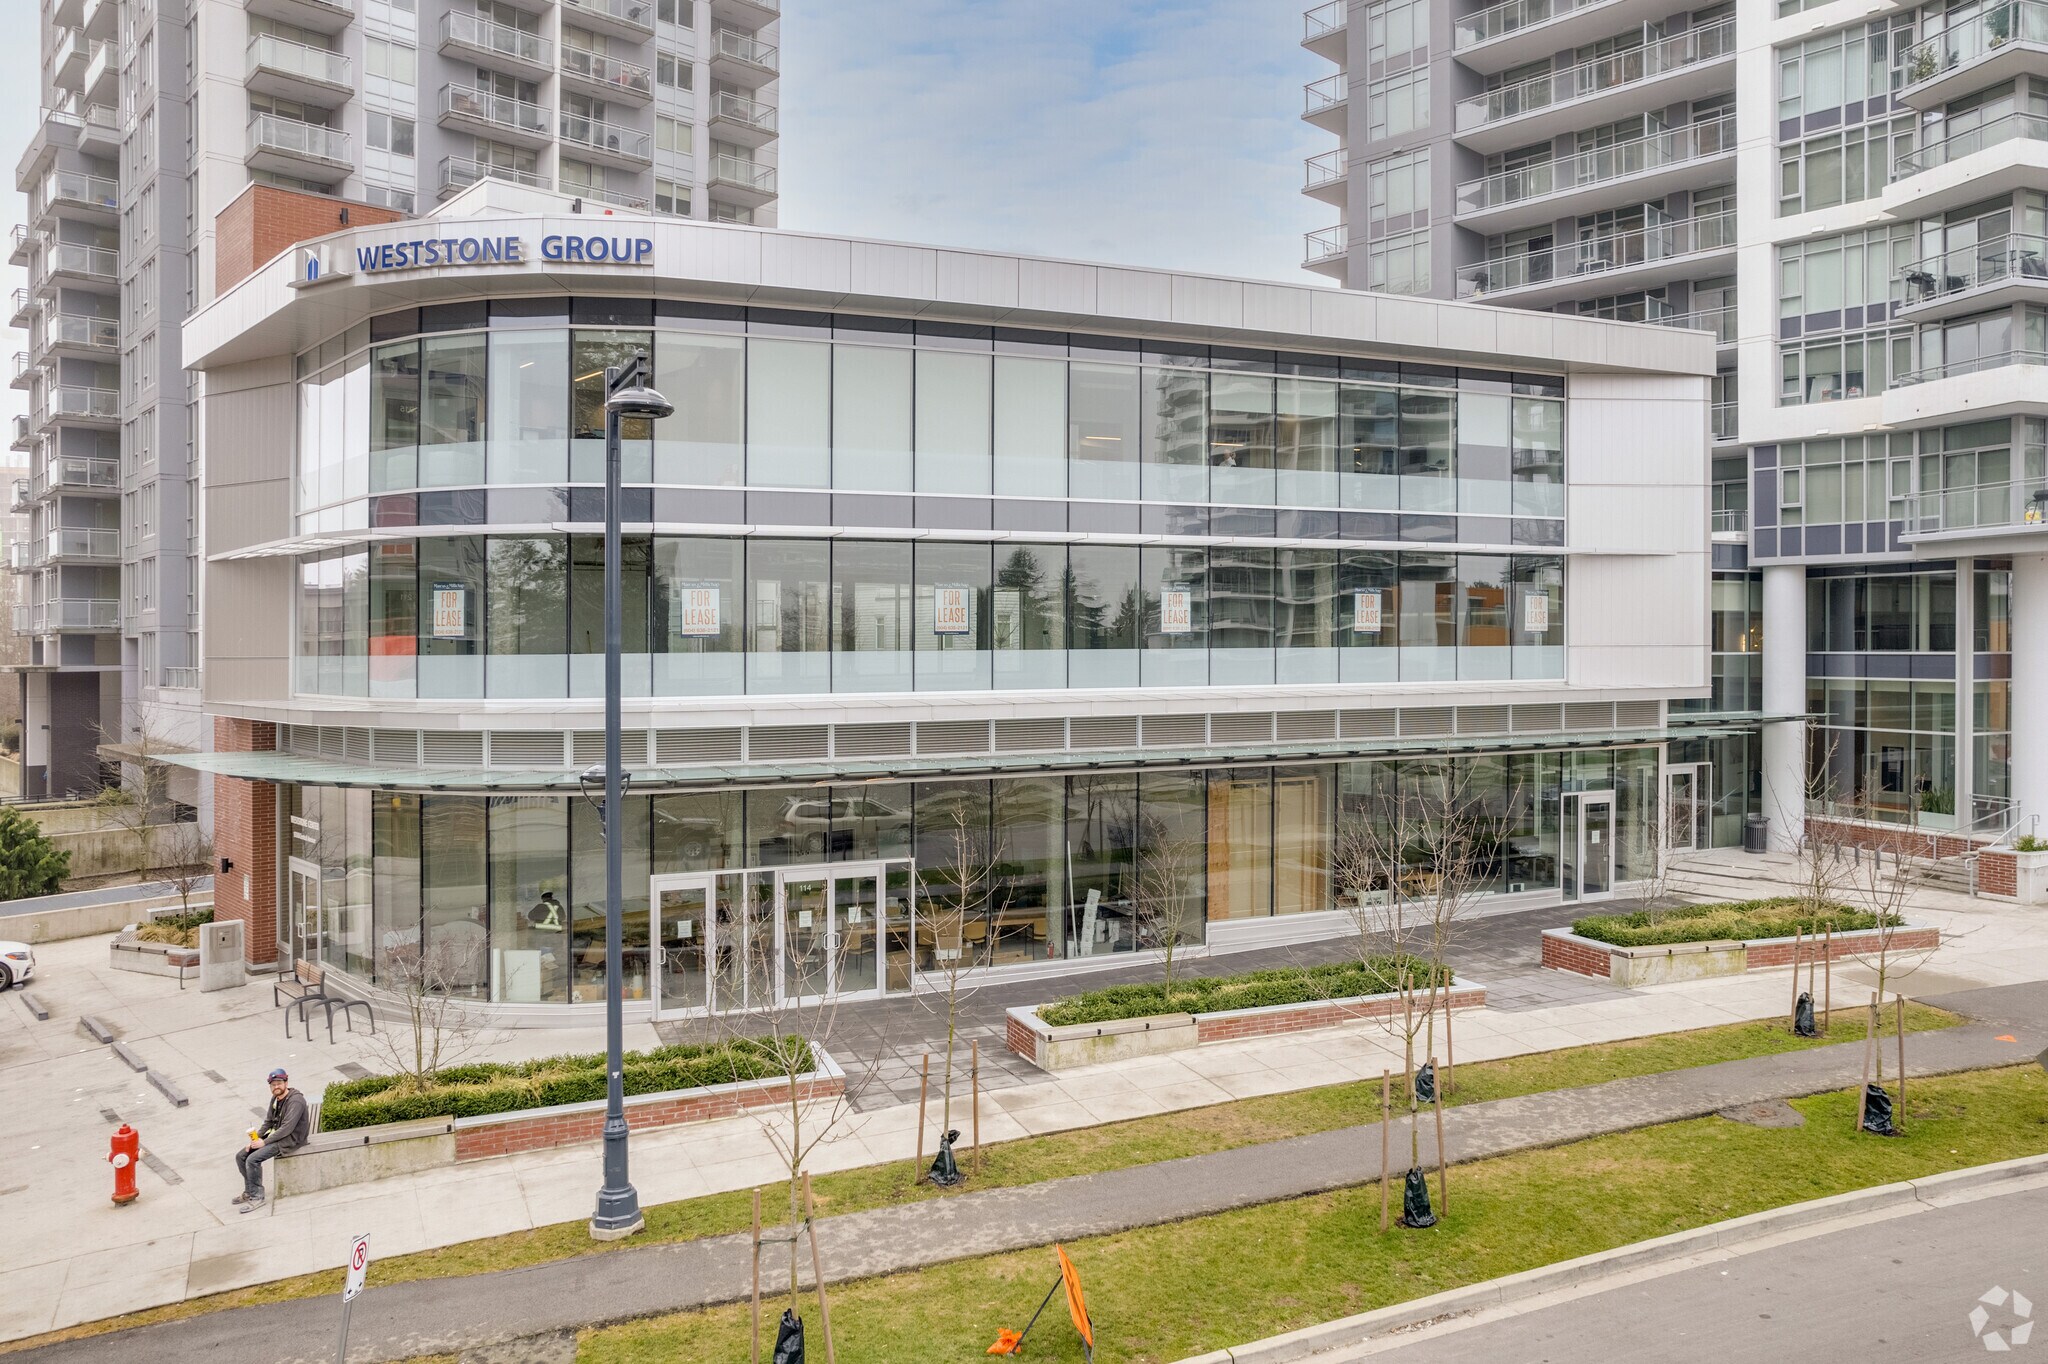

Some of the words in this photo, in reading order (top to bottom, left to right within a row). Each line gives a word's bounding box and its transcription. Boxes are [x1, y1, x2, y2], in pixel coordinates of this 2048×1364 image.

[356, 236, 521, 271] WESTSTONE
[541, 235, 654, 263] GROUP
[441, 591, 457, 608] FOR
[691, 590, 710, 606] FOR
[943, 590, 960, 605] FOR
[1168, 593, 1183, 607] FOR
[1361, 595, 1375, 608] FOR
[1531, 596, 1543, 609] FOR
[436, 610, 462, 626] LEASE
[685, 609, 716, 625] LEASE
[938, 607, 965, 623] LEASE
[1163, 609, 1188, 623] LEASE
[1356, 610, 1378, 623] LEASE
[1527, 611, 1546, 624] LEASE
[800, 884, 811, 892] 114
